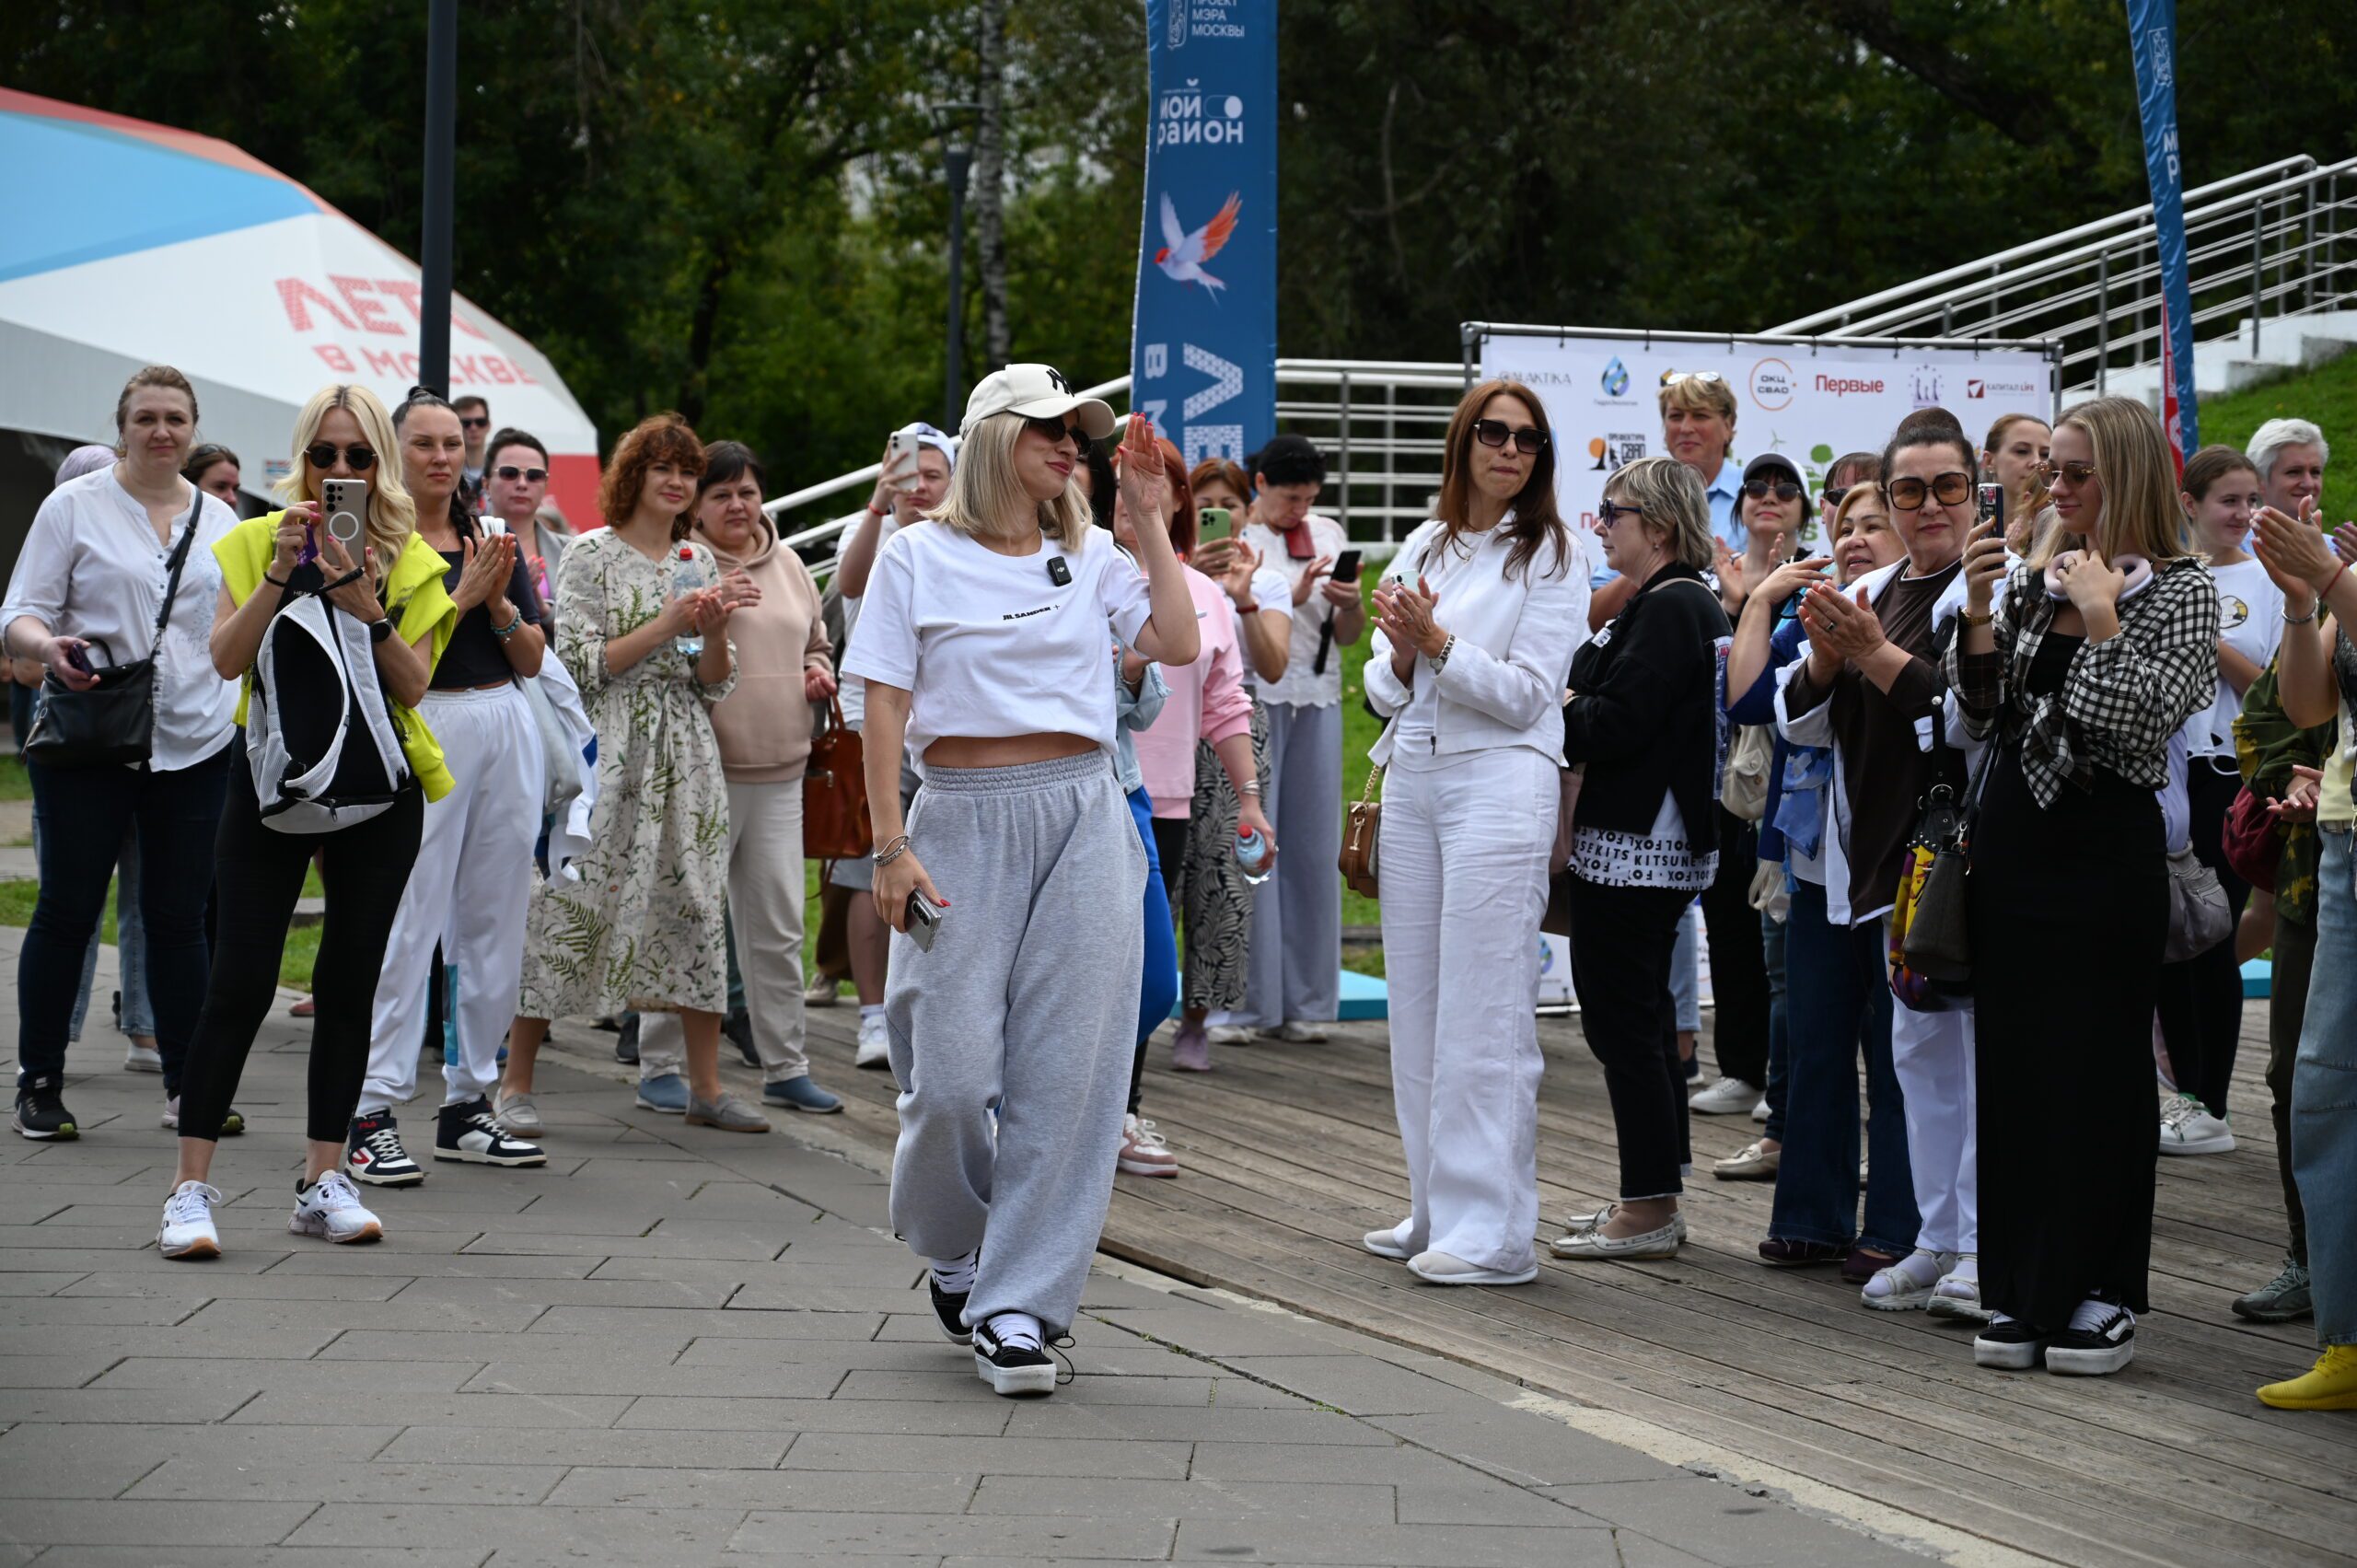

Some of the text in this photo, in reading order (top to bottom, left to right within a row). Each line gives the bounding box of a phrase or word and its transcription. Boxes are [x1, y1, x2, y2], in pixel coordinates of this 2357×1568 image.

[1192, 8, 1227, 21] МЭРА
[1191, 24, 1245, 37] МОСКВЫ
[1155, 120, 1244, 154] район
[274, 273, 492, 341] ЛЕТ
[1760, 375, 1785, 383] ОКЦ
[1816, 374, 1885, 397] Первые
[1757, 386, 1789, 394] СВАО
[1015, 607, 1051, 619] SANDER
